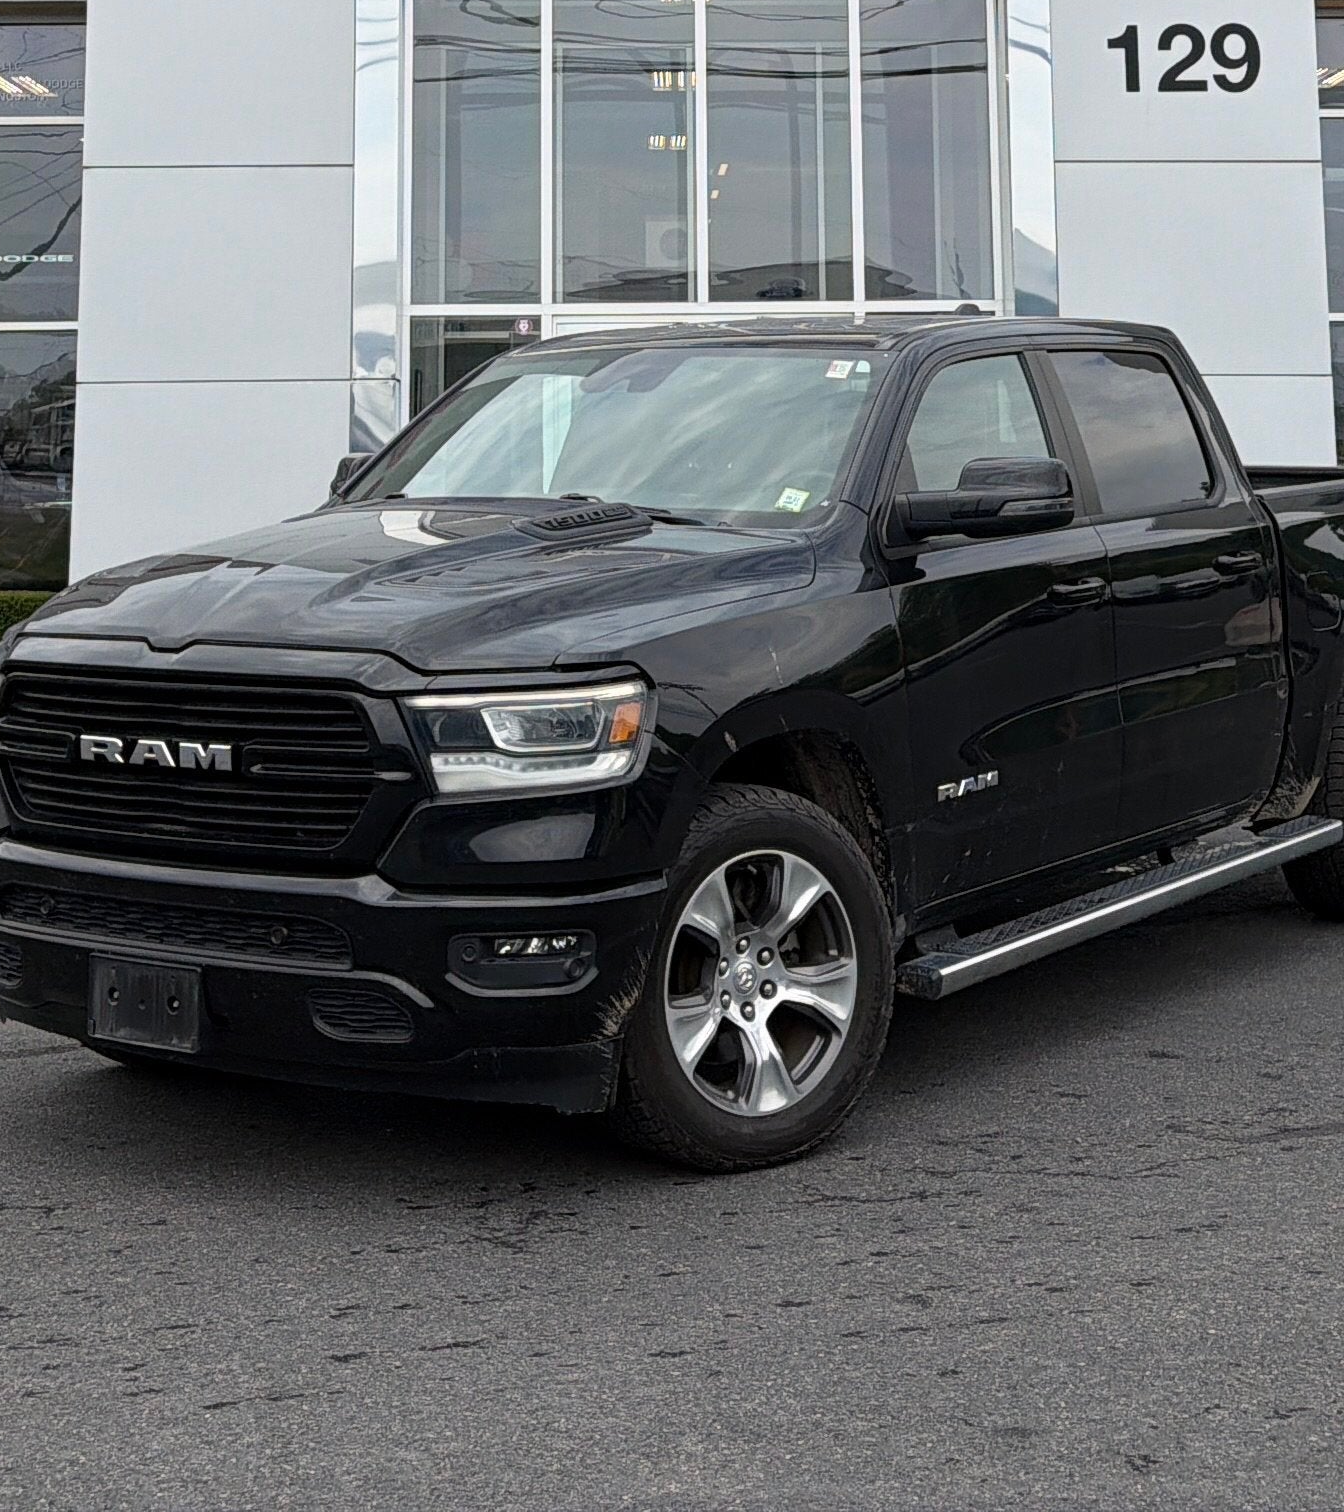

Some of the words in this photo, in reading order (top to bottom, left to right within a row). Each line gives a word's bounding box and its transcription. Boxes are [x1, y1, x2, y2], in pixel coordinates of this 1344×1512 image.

[1107, 22, 1262, 94] 129
[80, 734, 233, 772] RAM
[937, 770, 999, 803] RAM
